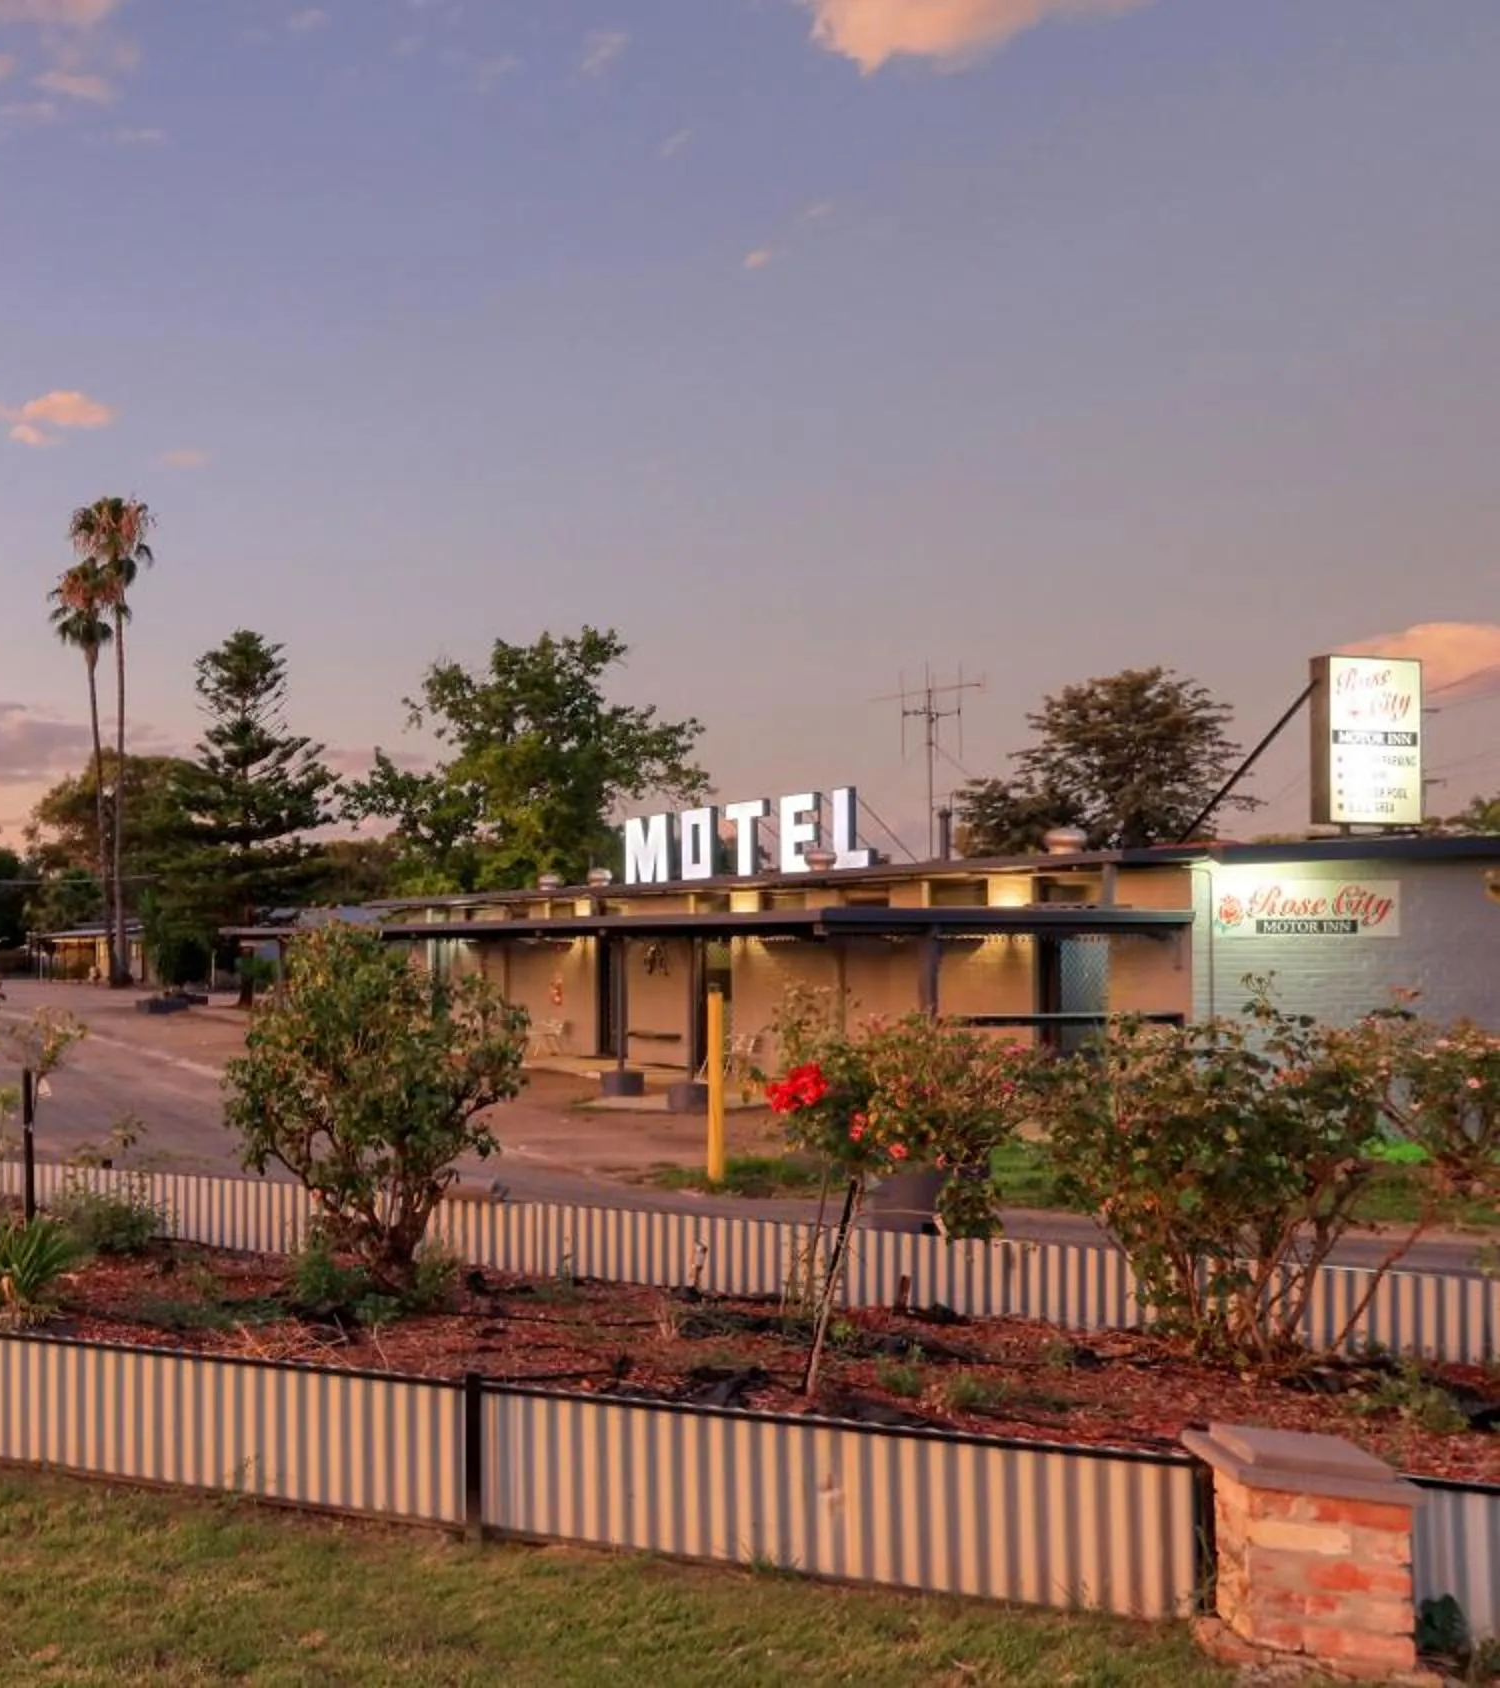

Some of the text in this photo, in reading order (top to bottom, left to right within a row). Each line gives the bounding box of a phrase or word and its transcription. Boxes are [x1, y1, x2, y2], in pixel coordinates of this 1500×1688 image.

[1387, 733, 1411, 745] INN
[625, 786, 878, 885] MOTEL
[1247, 885, 1394, 926] Rose City
[1263, 921, 1352, 933] MOTOR INN
